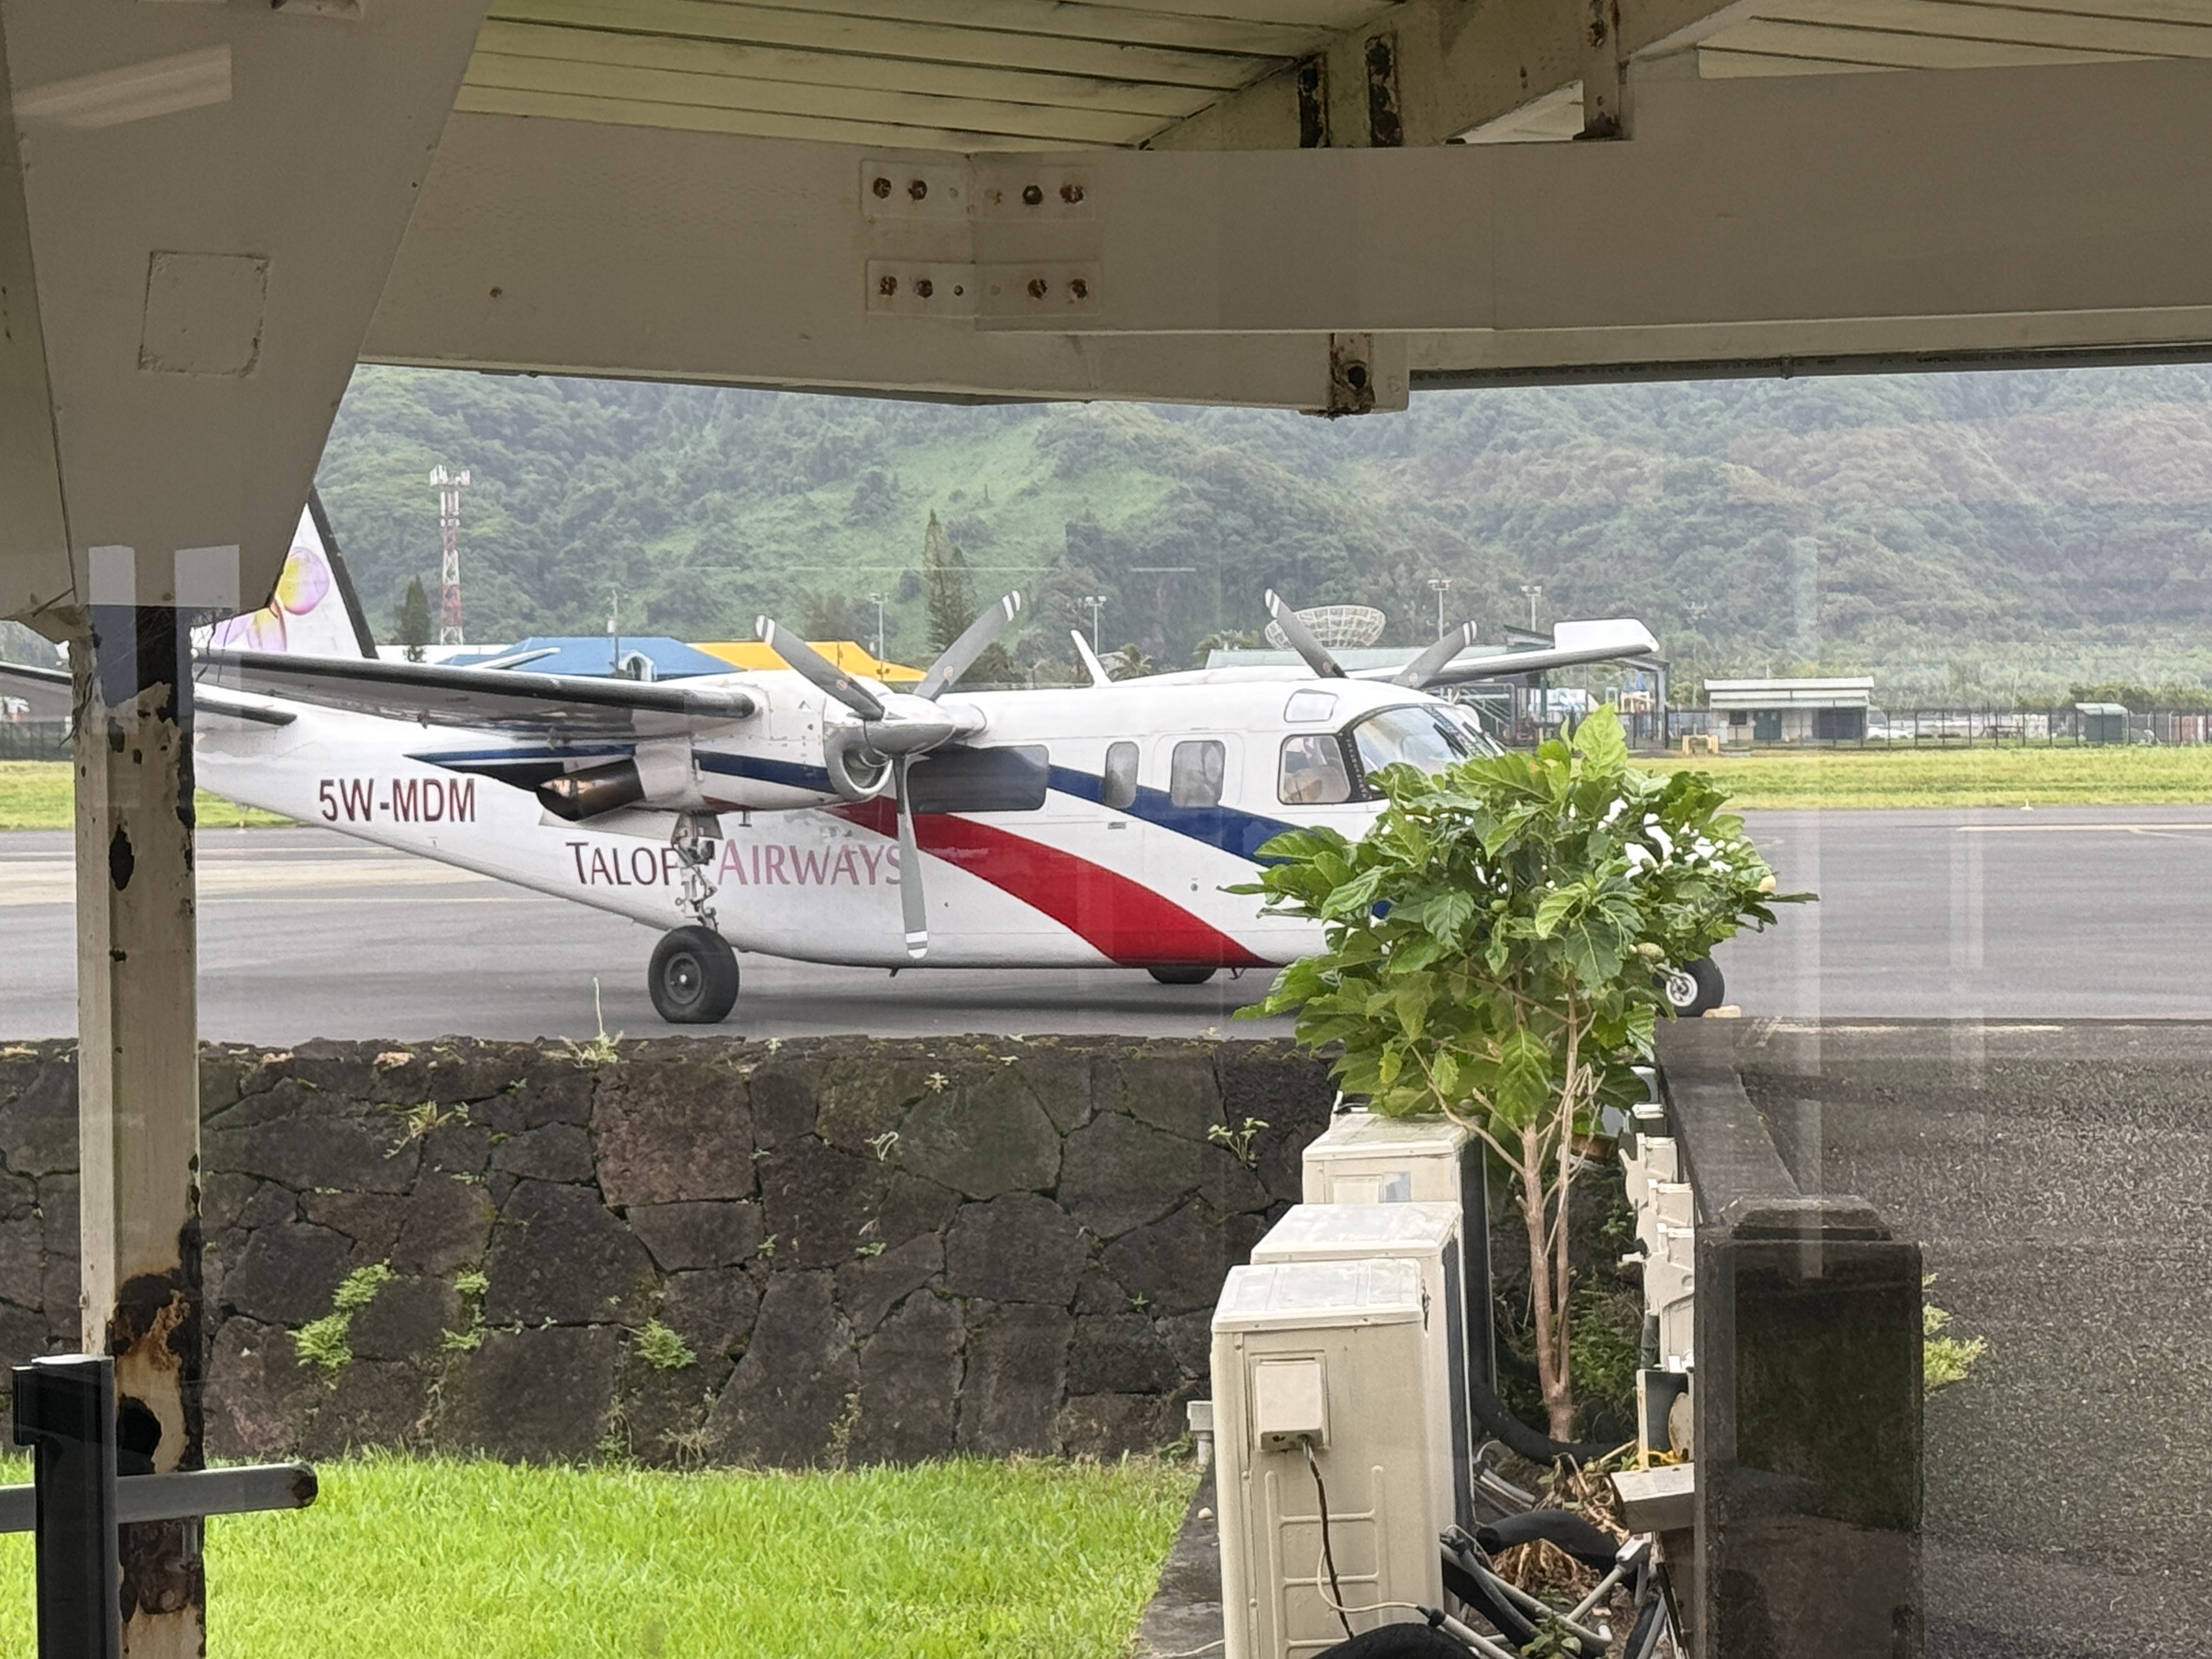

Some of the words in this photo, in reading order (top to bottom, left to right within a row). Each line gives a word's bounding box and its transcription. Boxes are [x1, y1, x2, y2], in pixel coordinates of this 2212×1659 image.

[319, 777, 476, 822] 5W-MDM
[565, 842, 686, 885] TALOF
[718, 839, 901, 885] AIRWAYS
